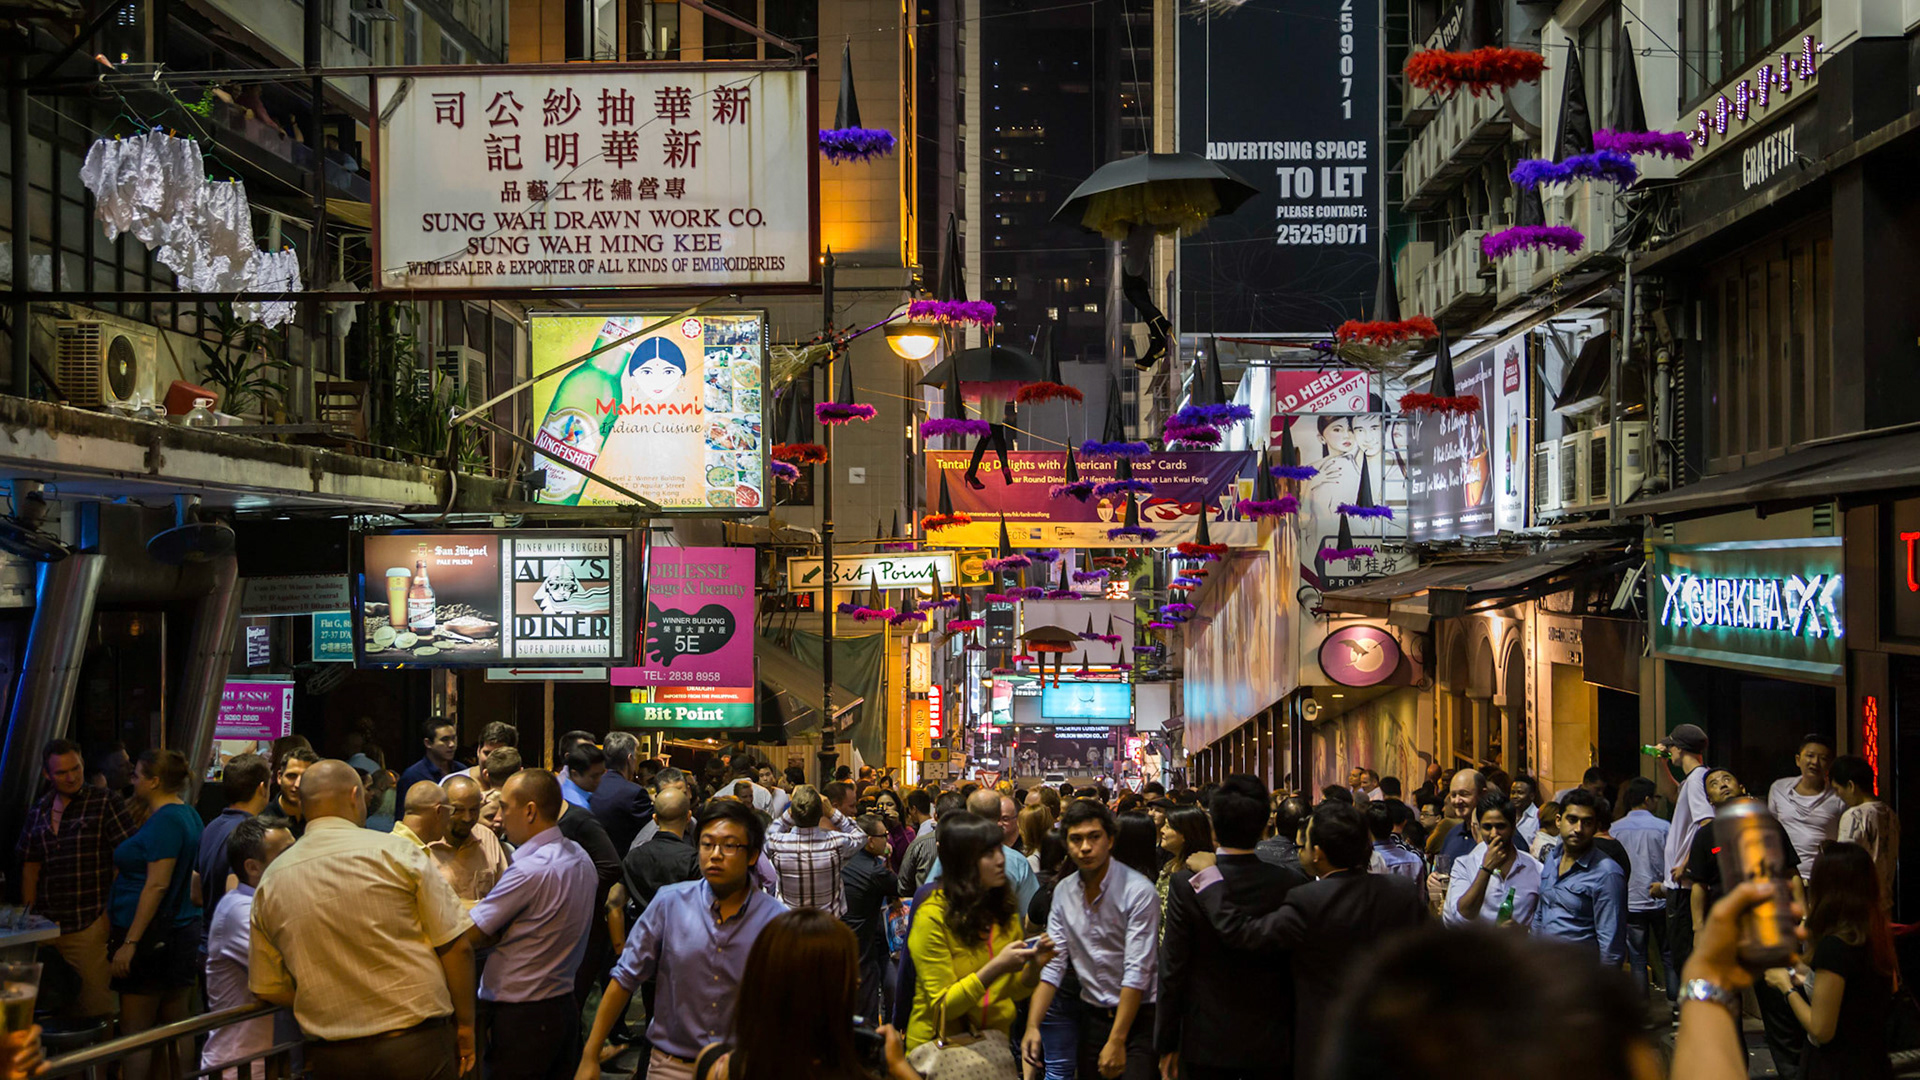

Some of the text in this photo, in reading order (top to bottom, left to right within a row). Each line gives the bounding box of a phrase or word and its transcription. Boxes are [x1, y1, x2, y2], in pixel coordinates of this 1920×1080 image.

[1206, 141, 1367, 160] ADVERTISING SPACE
[1742, 123, 1795, 190] GRAFFITI
[1276, 166, 1367, 198] TO LET
[422, 207, 767, 233] SUNG WAH DRAWN WORK CO.
[1277, 205, 1367, 218] PLEASE CONTACT:
[1277, 223, 1367, 245] 25259071
[467, 233, 722, 256] SUNG WAH MING KEE
[407, 255, 785, 277] WHOLESALER & EXPORTER OF ALL KINDS OF EMBROIDERIES
[1277, 369, 1344, 412] AD HERE
[1309, 375, 1367, 412] 2525 9071
[596, 395, 703, 416] Maharani
[600, 421, 702, 434] Indian Cuisine
[538, 432, 596, 471] KINGFISHER
[936, 458, 991, 471] Tantaliing
[993, 459, 1036, 472] Dlights
[1038, 458, 1061, 470] with
[1063, 460, 1112, 470] merican
[1158, 460, 1187, 470] Cards
[1191, 476, 1209, 485] Fong
[681, 497, 703, 506] 6525
[434, 545, 488, 557] San Miguel
[516, 542, 608, 552] DINER MITE BURGERS
[650, 563, 731, 580] OBLESSE
[878, 560, 941, 581] Point
[1347, 557, 1397, 572] 蘭桂坊
[683, 582, 697, 595] &
[699, 581, 746, 599] beauty
[1687, 578, 1785, 631] GURKHA
[320, 619, 333, 628] Flat
[516, 616, 609, 638] DINER
[662, 617, 726, 625] WINNER BUILDING
[518, 643, 607, 654] SUPER DUPER MALTS
[674, 634, 700, 653] 5E
[643, 671, 721, 682] TEL: 2838 8958
[644, 706, 724, 721] Bit Point
